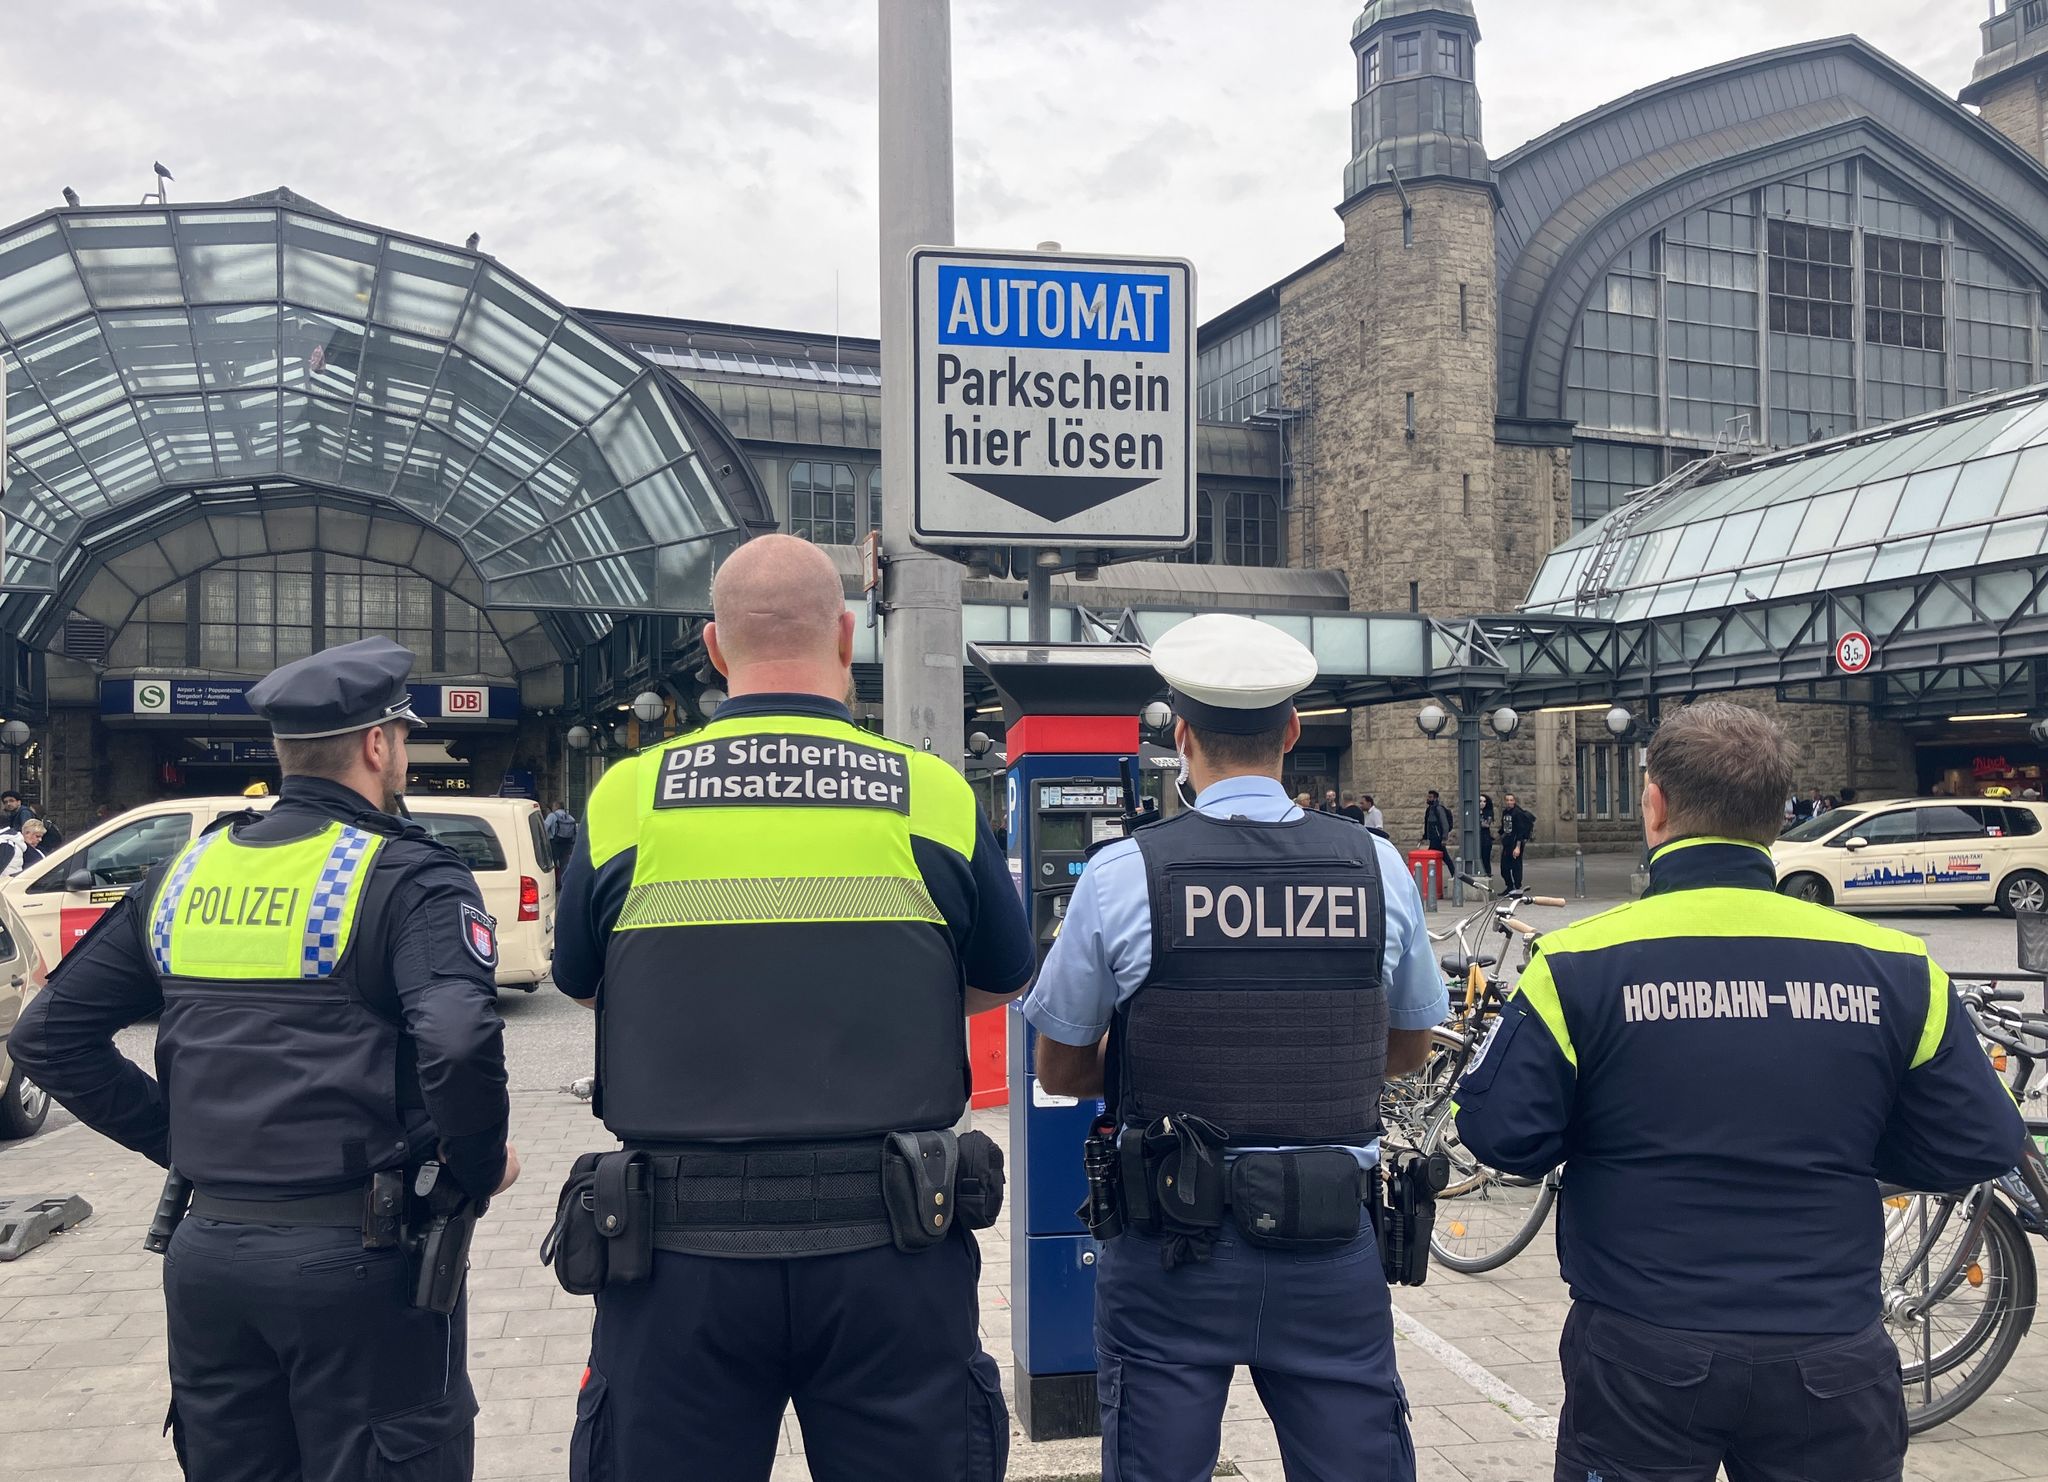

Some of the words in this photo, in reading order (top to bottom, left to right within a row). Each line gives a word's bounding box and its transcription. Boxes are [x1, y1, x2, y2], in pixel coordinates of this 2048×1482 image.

[946, 276, 1164, 342] AUTOMAT
[936, 353, 1170, 412] Parkschein
[945, 413, 1032, 467] hier
[1047, 416, 1163, 471] lösen
[453, 694, 478, 709] DB
[667, 744, 716, 771] DB
[727, 738, 902, 777] Sicherheit
[924, 738, 931, 750] P
[663, 769, 903, 804] Einsatzleiter
[1008, 777, 1017, 834] P
[185, 886, 299, 926] POLIZEI
[1185, 885, 1367, 938] POLIZEI
[1623, 980, 1881, 1026] HOCHBAHN-WACHE
